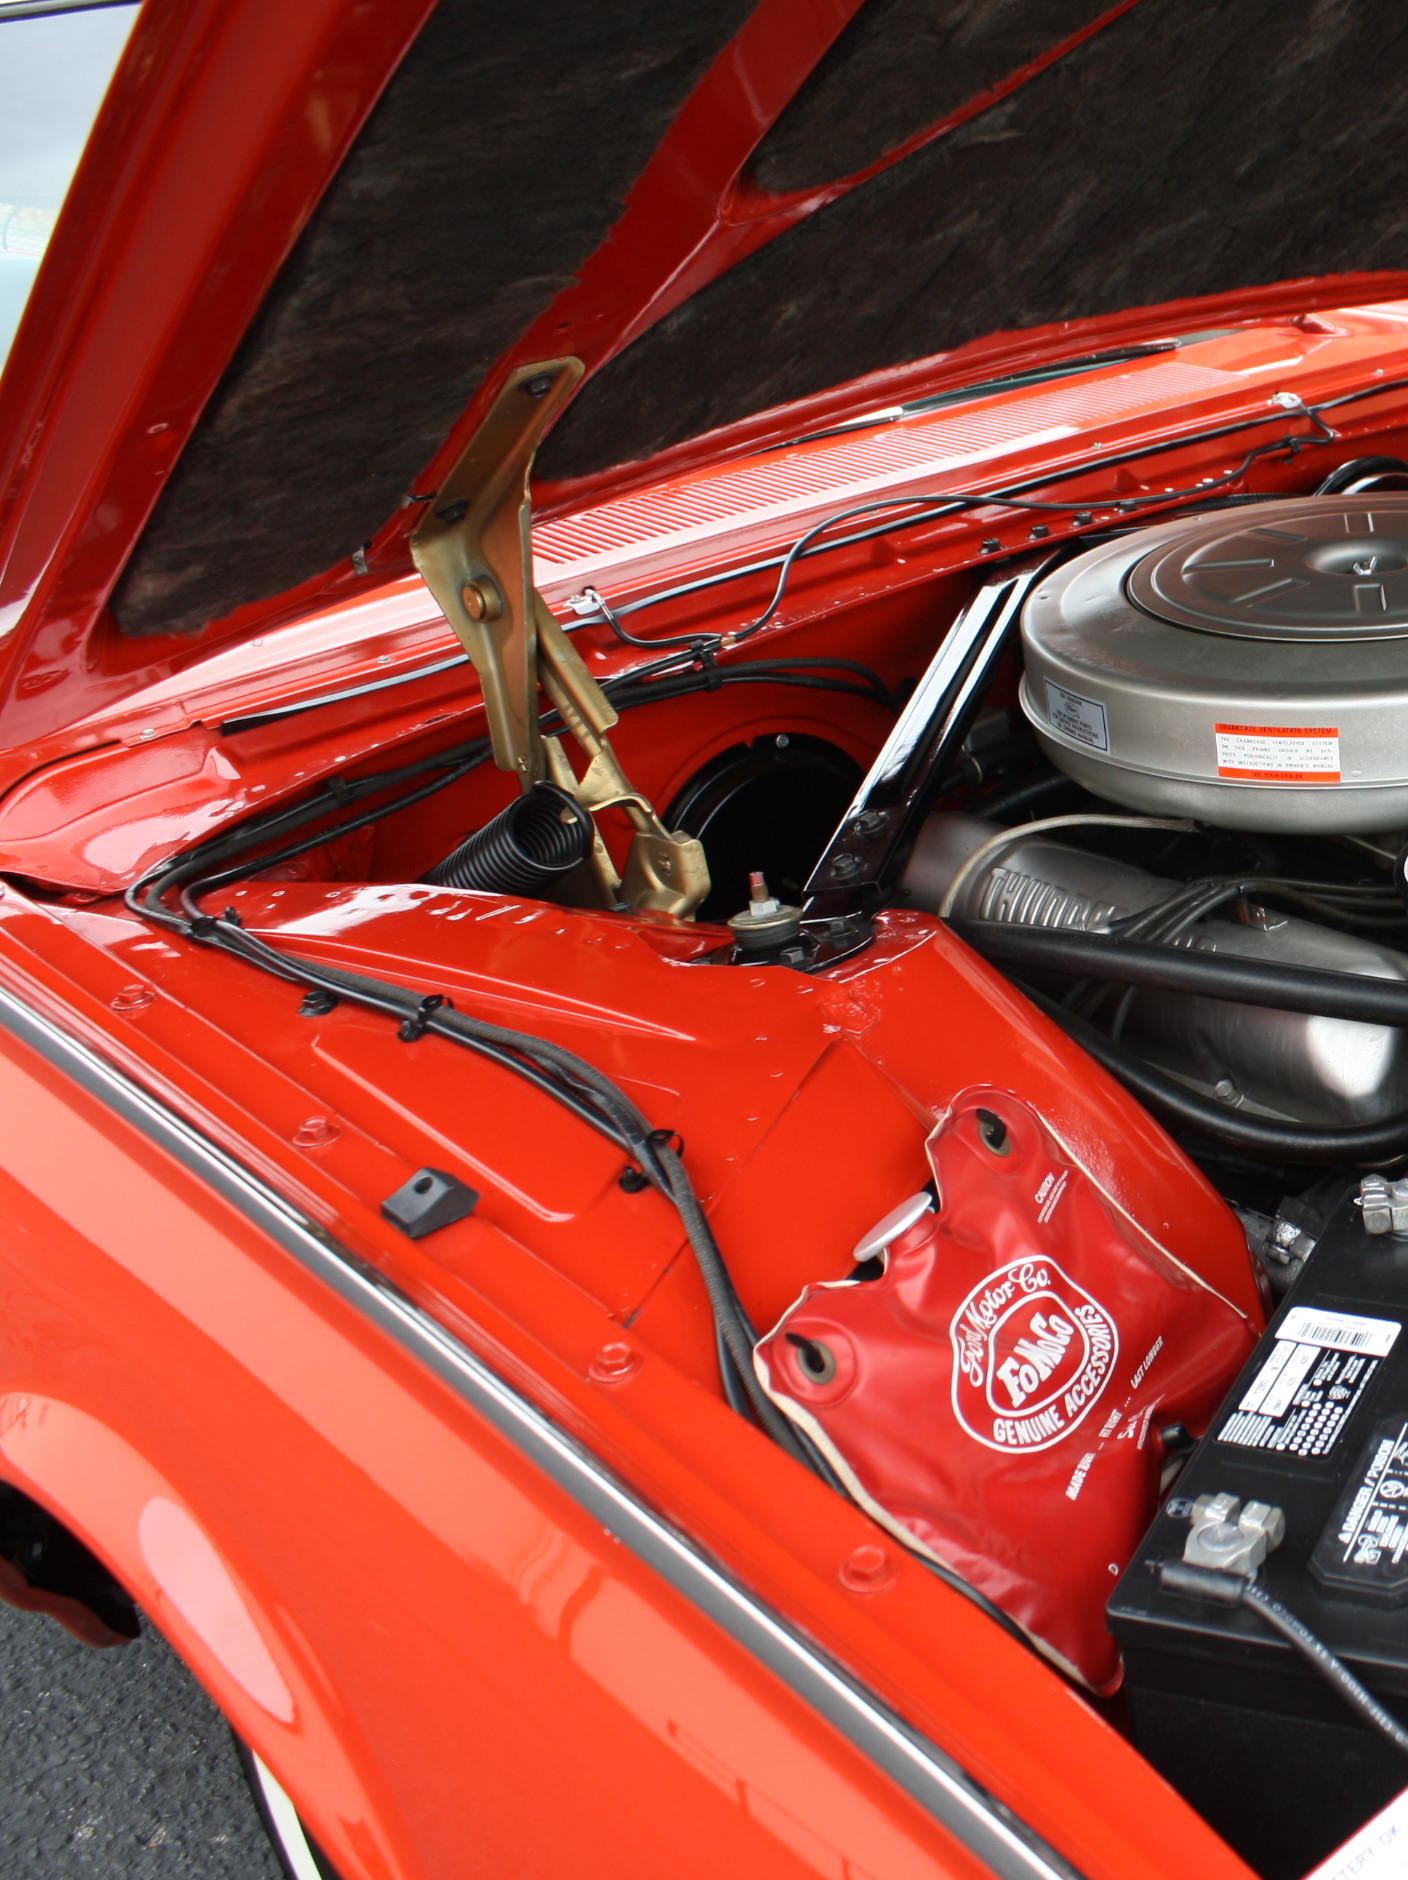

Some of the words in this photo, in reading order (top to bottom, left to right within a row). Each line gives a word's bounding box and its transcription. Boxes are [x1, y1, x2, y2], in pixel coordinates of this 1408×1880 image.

[1219, 723, 1256, 733] CRANKCASE
[1259, 725, 1301, 735] VENTILATION
[1034, 1171, 1055, 1204] CAUTION
[965, 1281, 1016, 1333] Motor
[1008, 1263, 1052, 1293] Co.
[958, 1323, 987, 1388] Ford
[992, 1404, 1066, 1446] GENUINE
[1064, 1303, 1112, 1418] ACCESSORIES
[996, 1311, 1075, 1408] FoMoCo
[1064, 1468, 1088, 1501] MADE
[1130, 1364, 1145, 1390] LAST
[1142, 1335, 1164, 1371] LONGER
[1341, 1486, 1374, 1533] DANGER
[1366, 1438, 1395, 1479] POISON
[1379, 1823, 1403, 1846] OK
